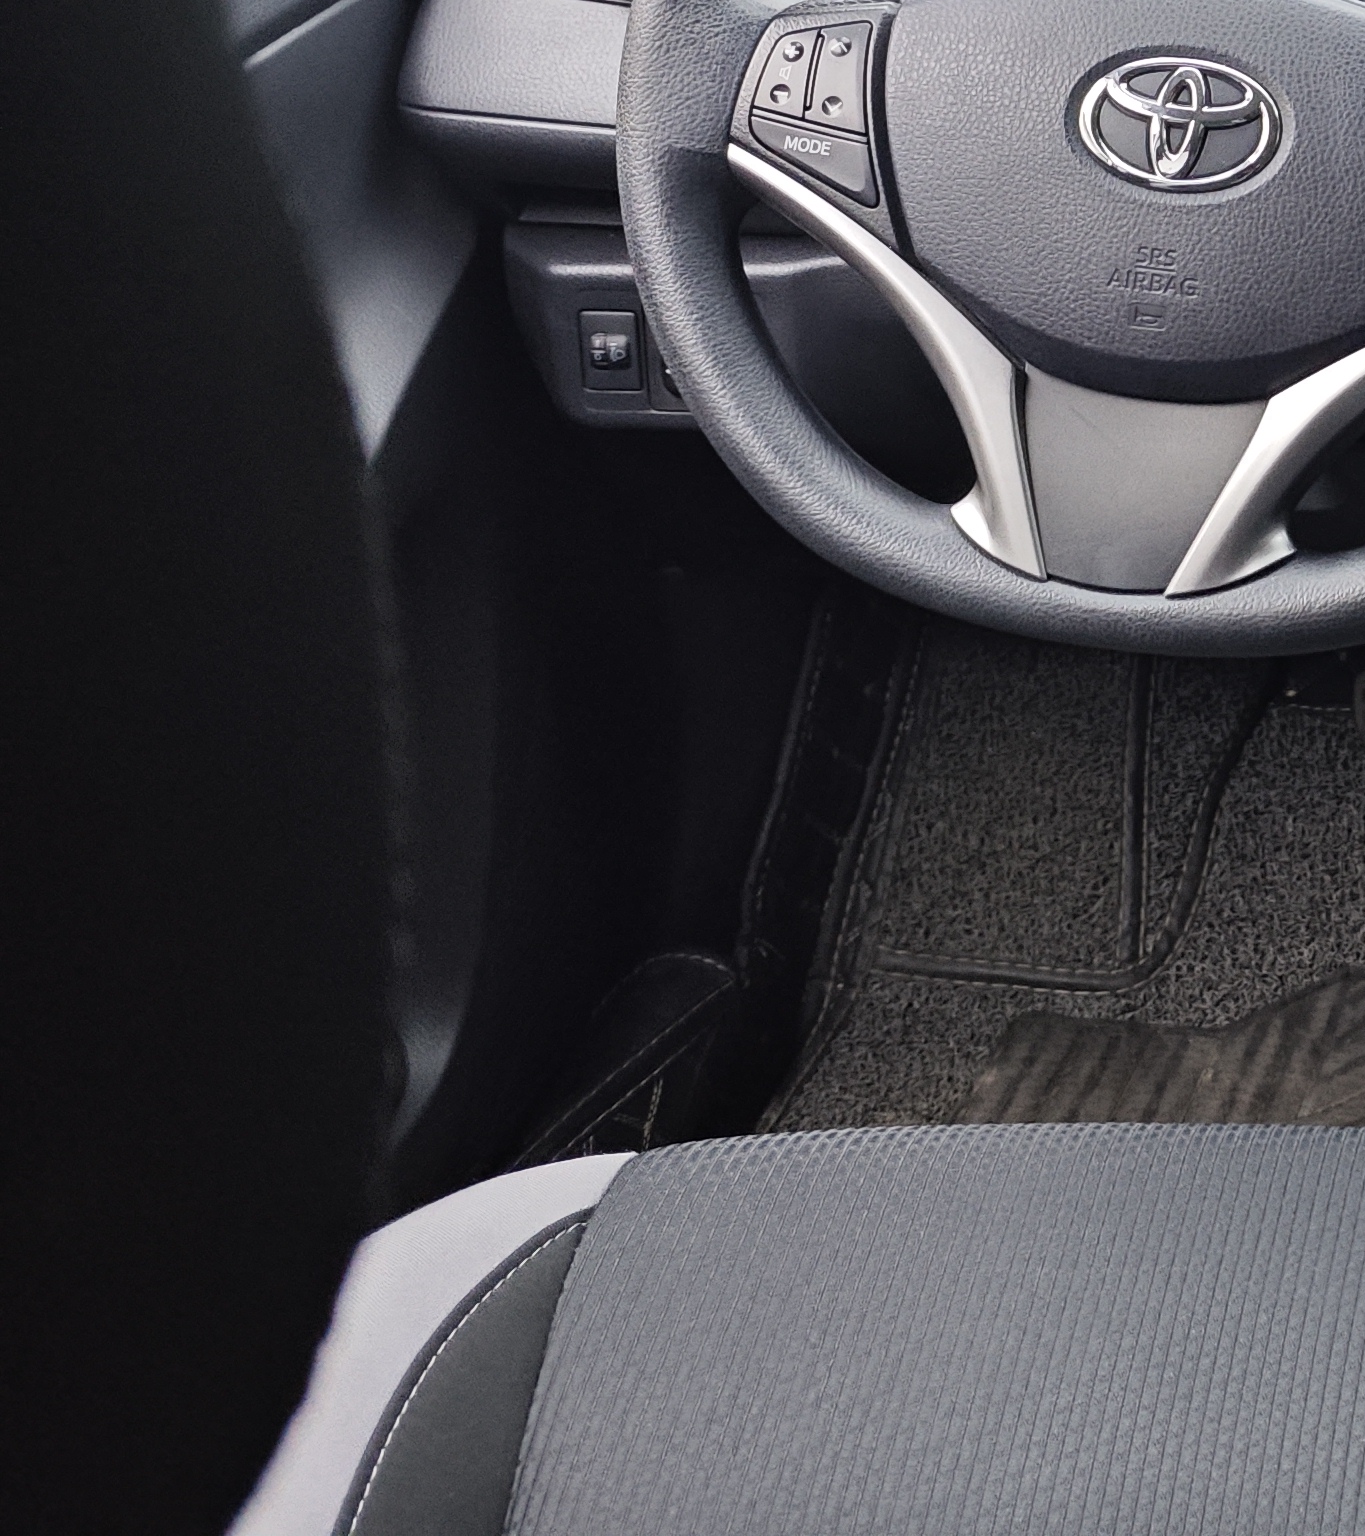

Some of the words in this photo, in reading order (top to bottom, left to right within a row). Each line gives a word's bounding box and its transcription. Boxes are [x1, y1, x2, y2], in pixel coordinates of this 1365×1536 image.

[784, 134, 832, 156] MODE
[1135, 245, 1178, 266] SRS
[1106, 267, 1200, 298] AIRBAG
